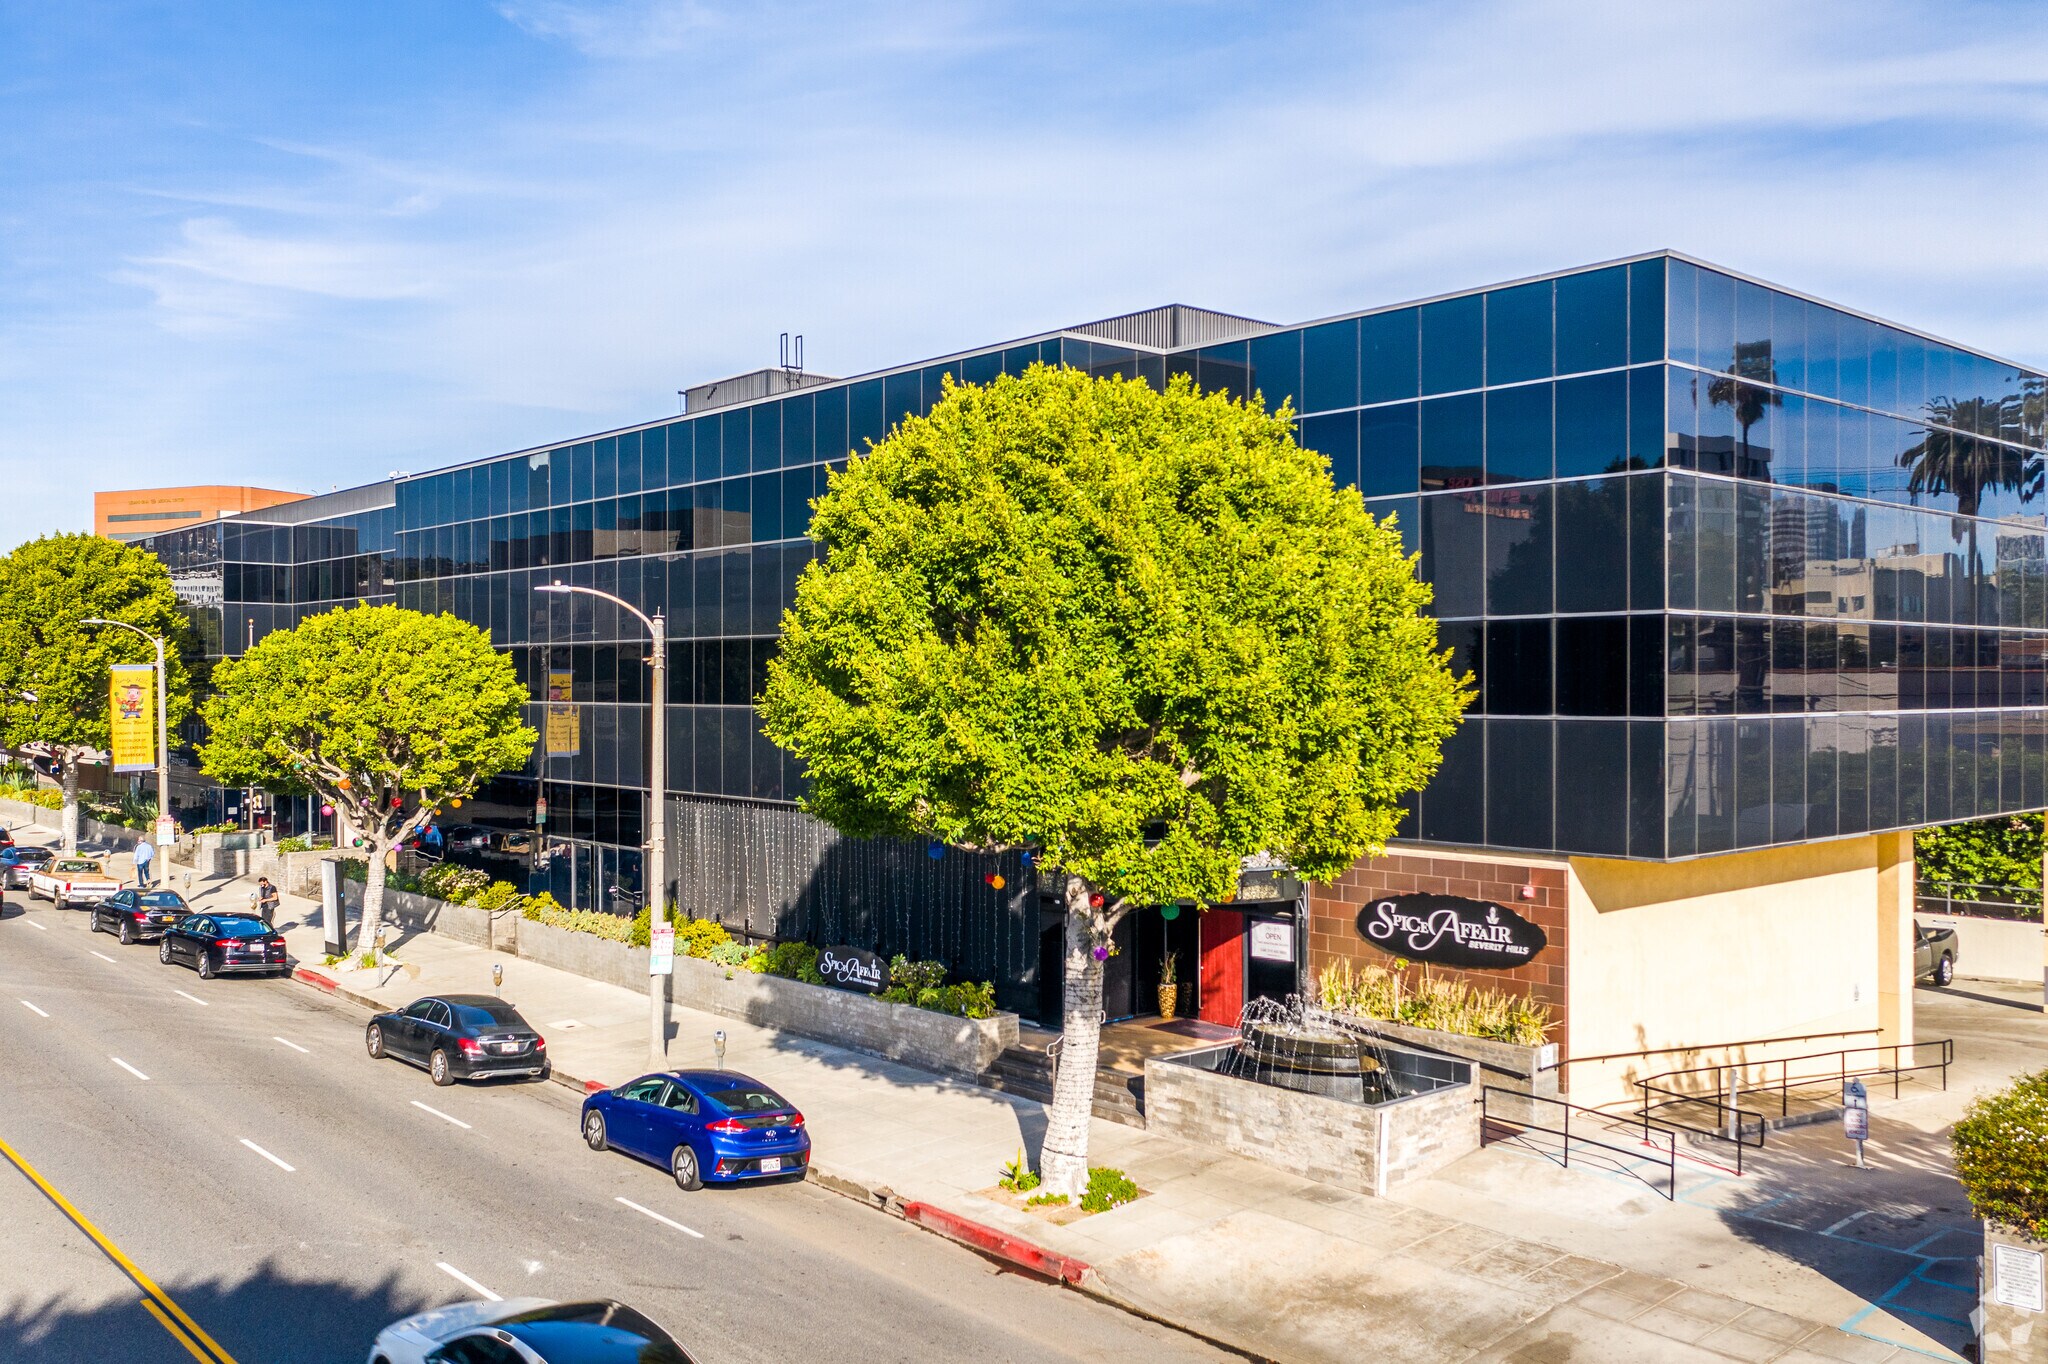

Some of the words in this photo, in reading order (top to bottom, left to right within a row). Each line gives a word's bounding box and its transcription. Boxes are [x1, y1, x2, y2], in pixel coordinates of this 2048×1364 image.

[1265, 932, 1281, 940] OPEN
[1368, 901, 1430, 939] SPICE
[1408, 909, 1514, 951] AFFAIR
[1468, 940, 1505, 952] BEVERLY
[1505, 944, 1530, 956] HILLS
[820, 951, 847, 974] SPICE
[837, 958, 881, 982] AFFAIR
